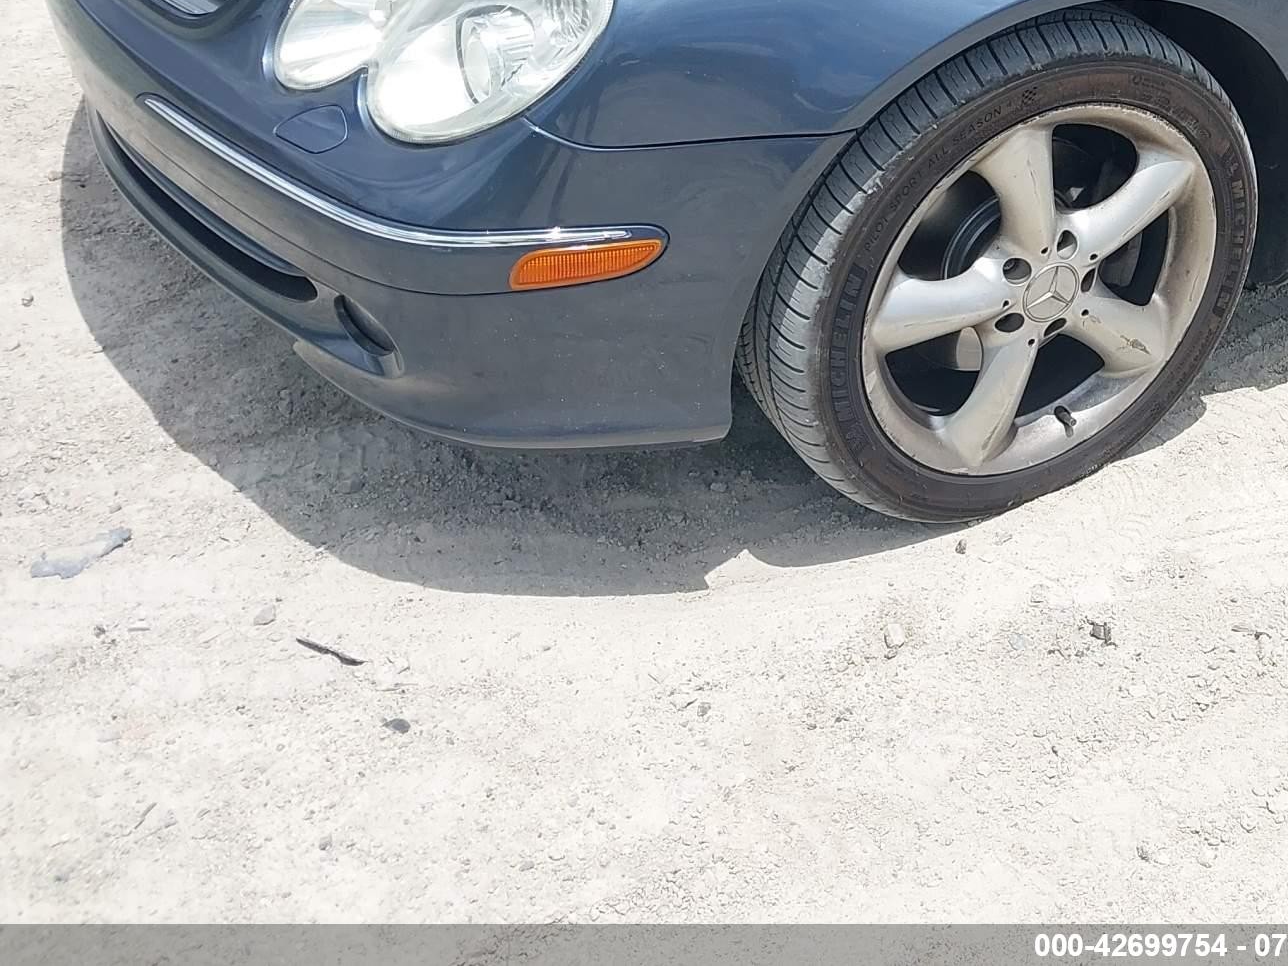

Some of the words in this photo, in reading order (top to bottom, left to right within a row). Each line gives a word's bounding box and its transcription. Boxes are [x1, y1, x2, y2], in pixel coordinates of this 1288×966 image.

[927, 145, 950, 171] ALL
[952, 104, 1003, 145] SEASON
[831, 272, 862, 423] MICHELIN
